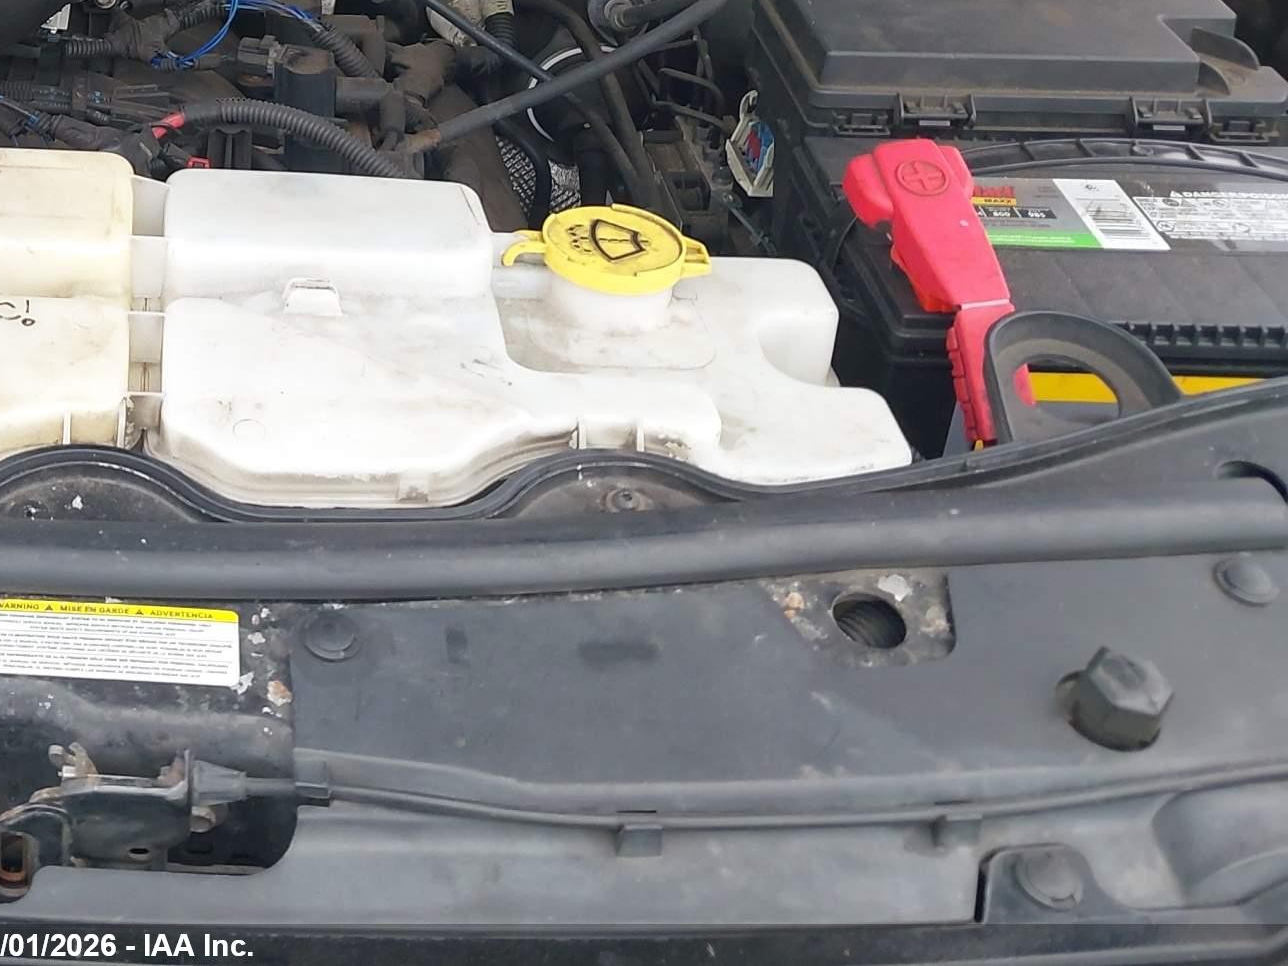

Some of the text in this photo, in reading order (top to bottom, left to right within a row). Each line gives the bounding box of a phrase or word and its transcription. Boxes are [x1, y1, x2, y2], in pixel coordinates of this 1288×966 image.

[59, 605, 82, 613] MISE
[99, 607, 130, 615] GARDE
[150, 609, 214, 619] ADVERTENCIA
